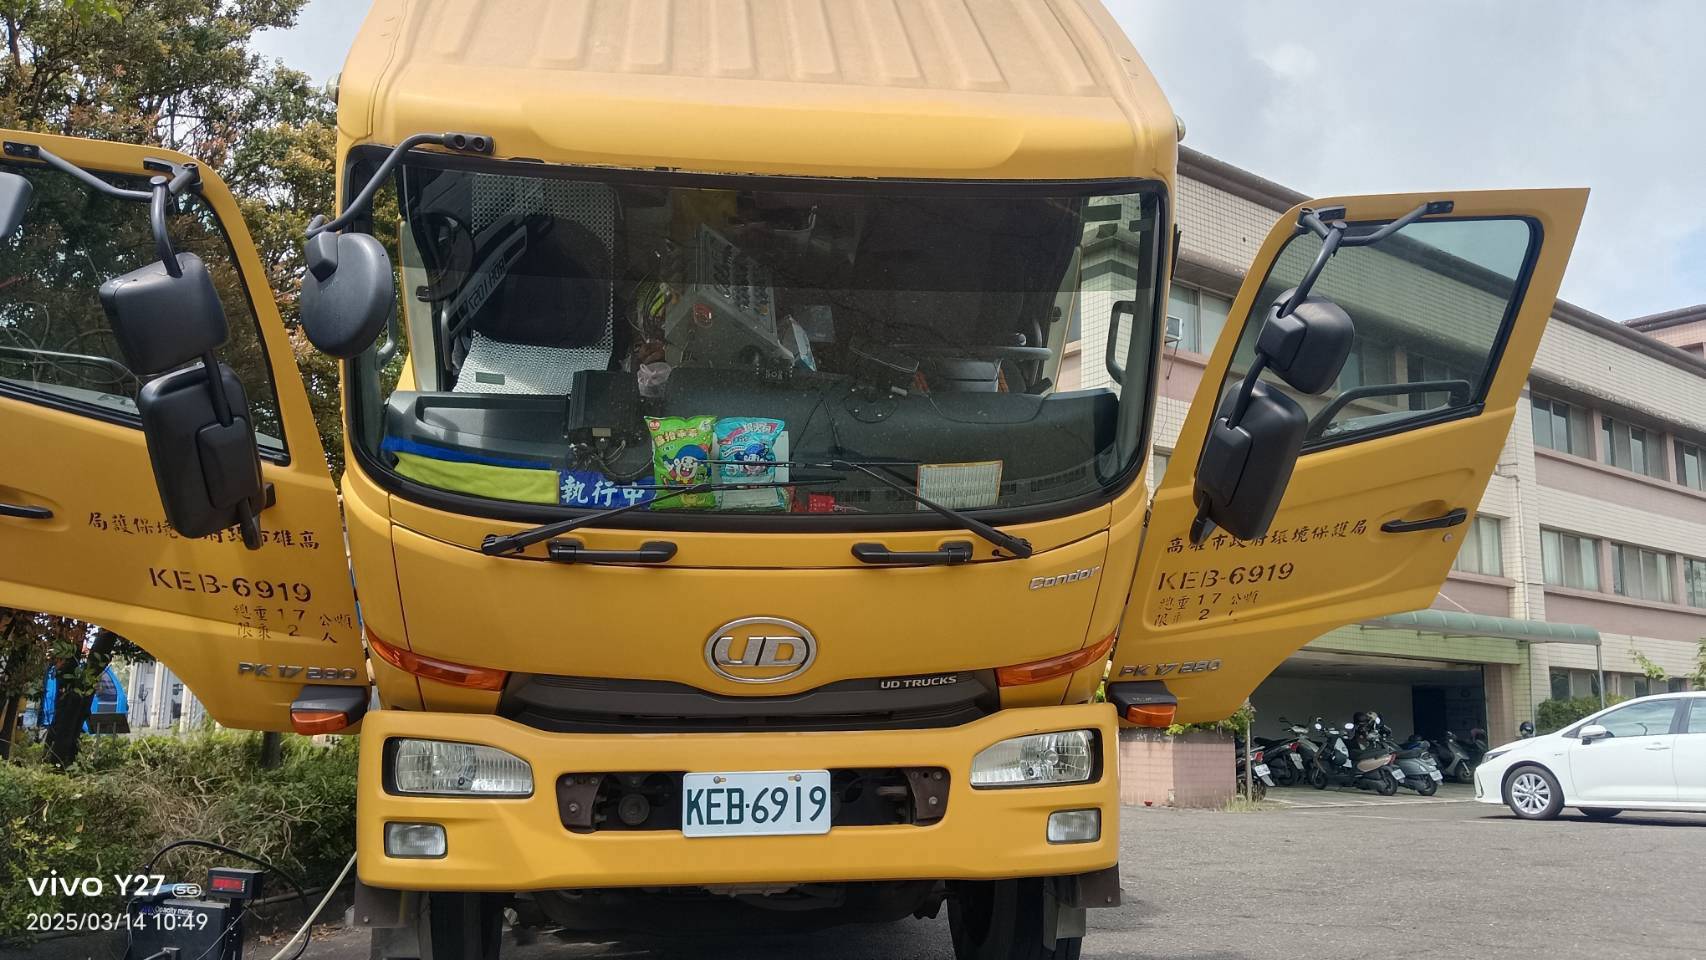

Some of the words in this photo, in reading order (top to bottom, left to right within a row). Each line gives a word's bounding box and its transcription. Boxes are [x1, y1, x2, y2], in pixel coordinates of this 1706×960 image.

[560, 475, 646, 507] 執行中
[149, 567, 312, 603] KEB-6919
[1030, 566, 1100, 589] Condor
[1158, 562, 1295, 591] KEB-6919
[1198, 608, 1210, 621] 2
[288, 625, 301, 637] 2
[321, 632, 338, 644] 人
[714, 636, 808, 666] UD
[881, 680, 900, 689] UD
[904, 675, 957, 688] TRUCKS
